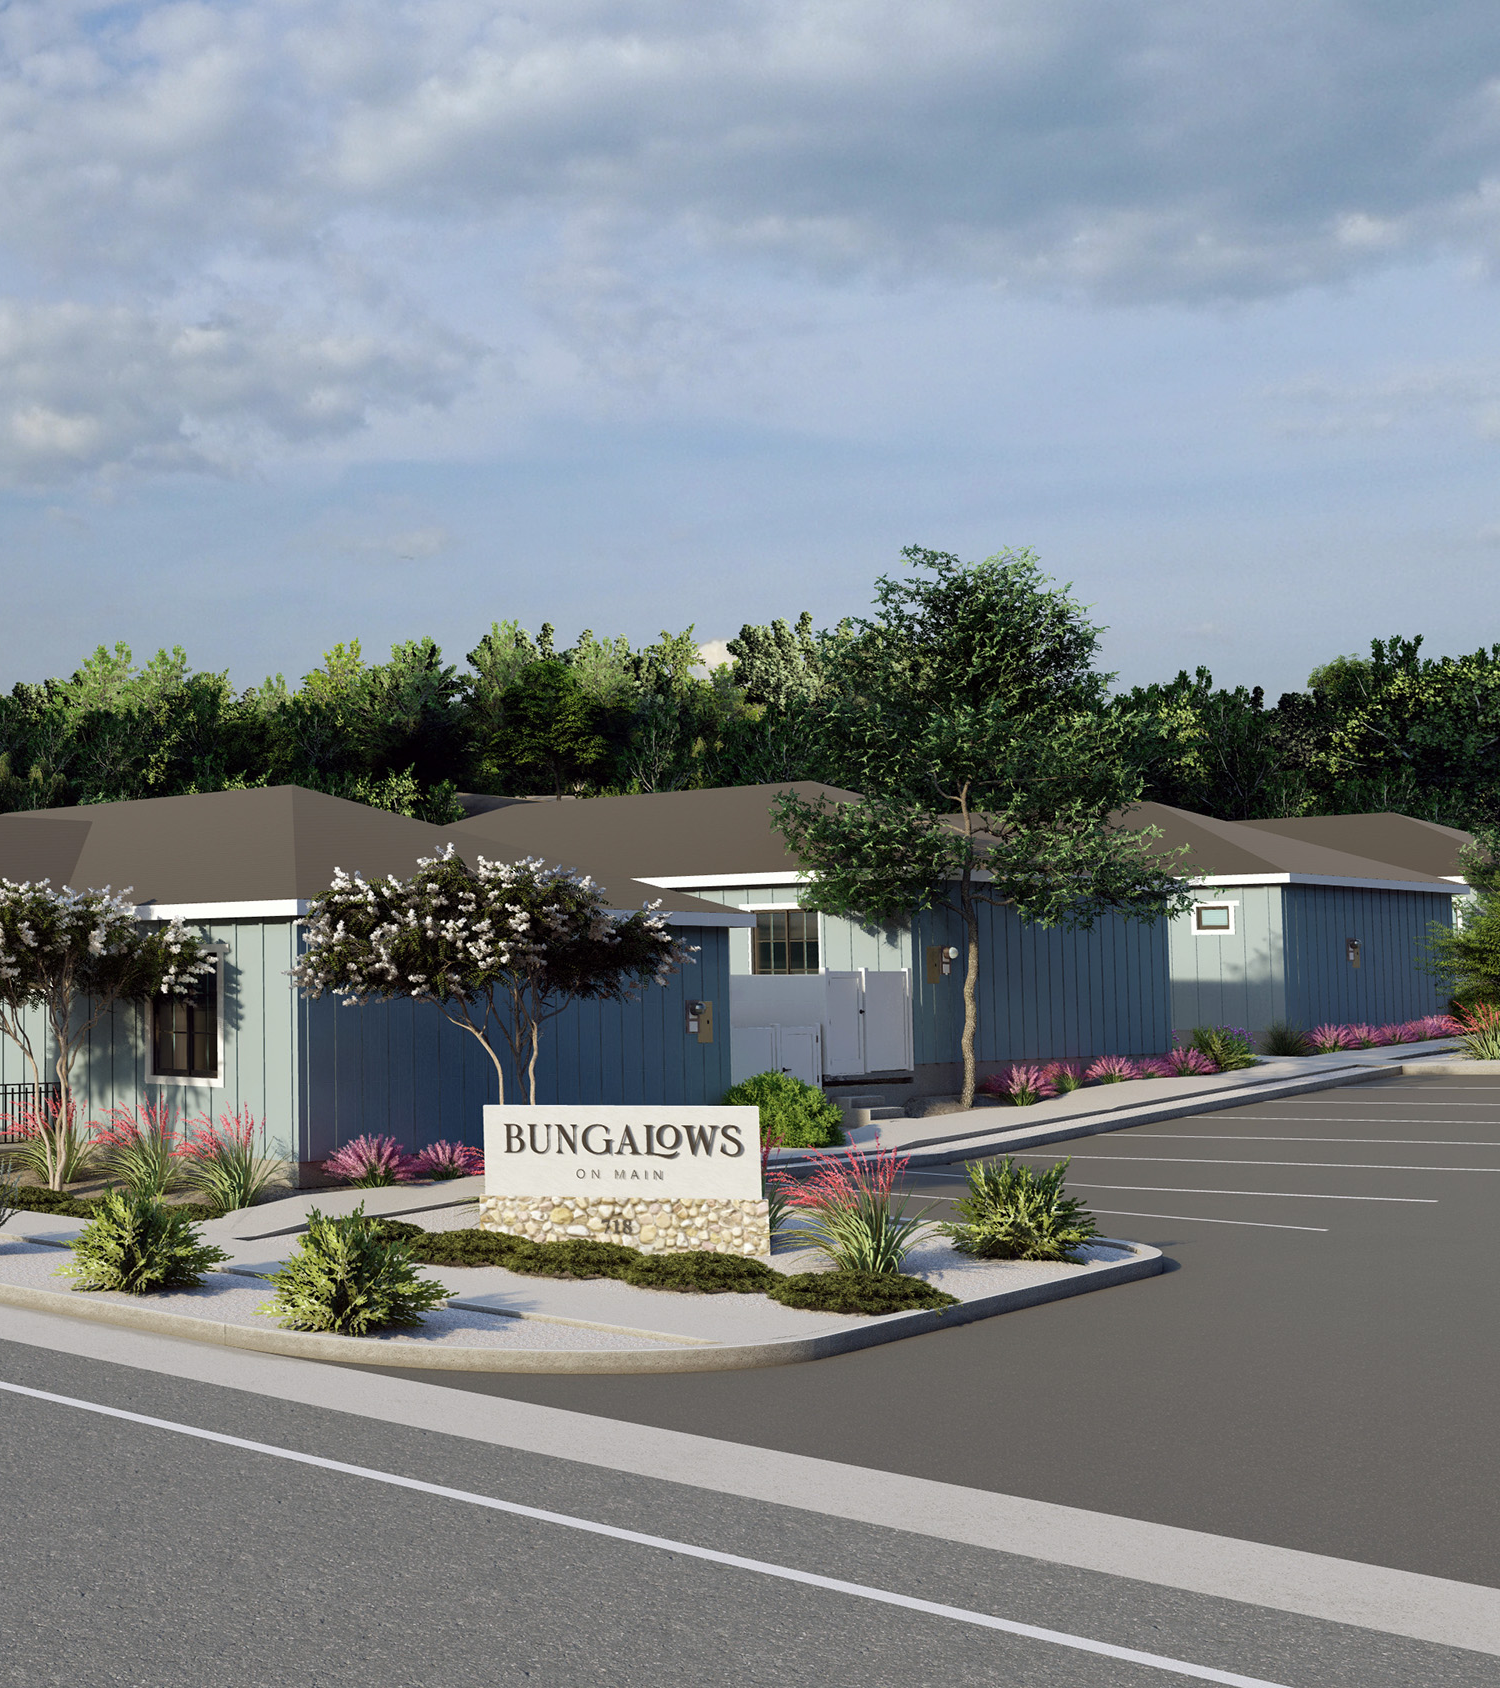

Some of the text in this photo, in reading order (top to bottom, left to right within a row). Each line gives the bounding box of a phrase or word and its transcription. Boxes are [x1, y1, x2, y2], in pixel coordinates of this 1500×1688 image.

[503, 1123, 744, 1159] BUNGALOWS
[576, 1168, 664, 1180] ON MAIN
[601, 1219, 633, 1235] 718
